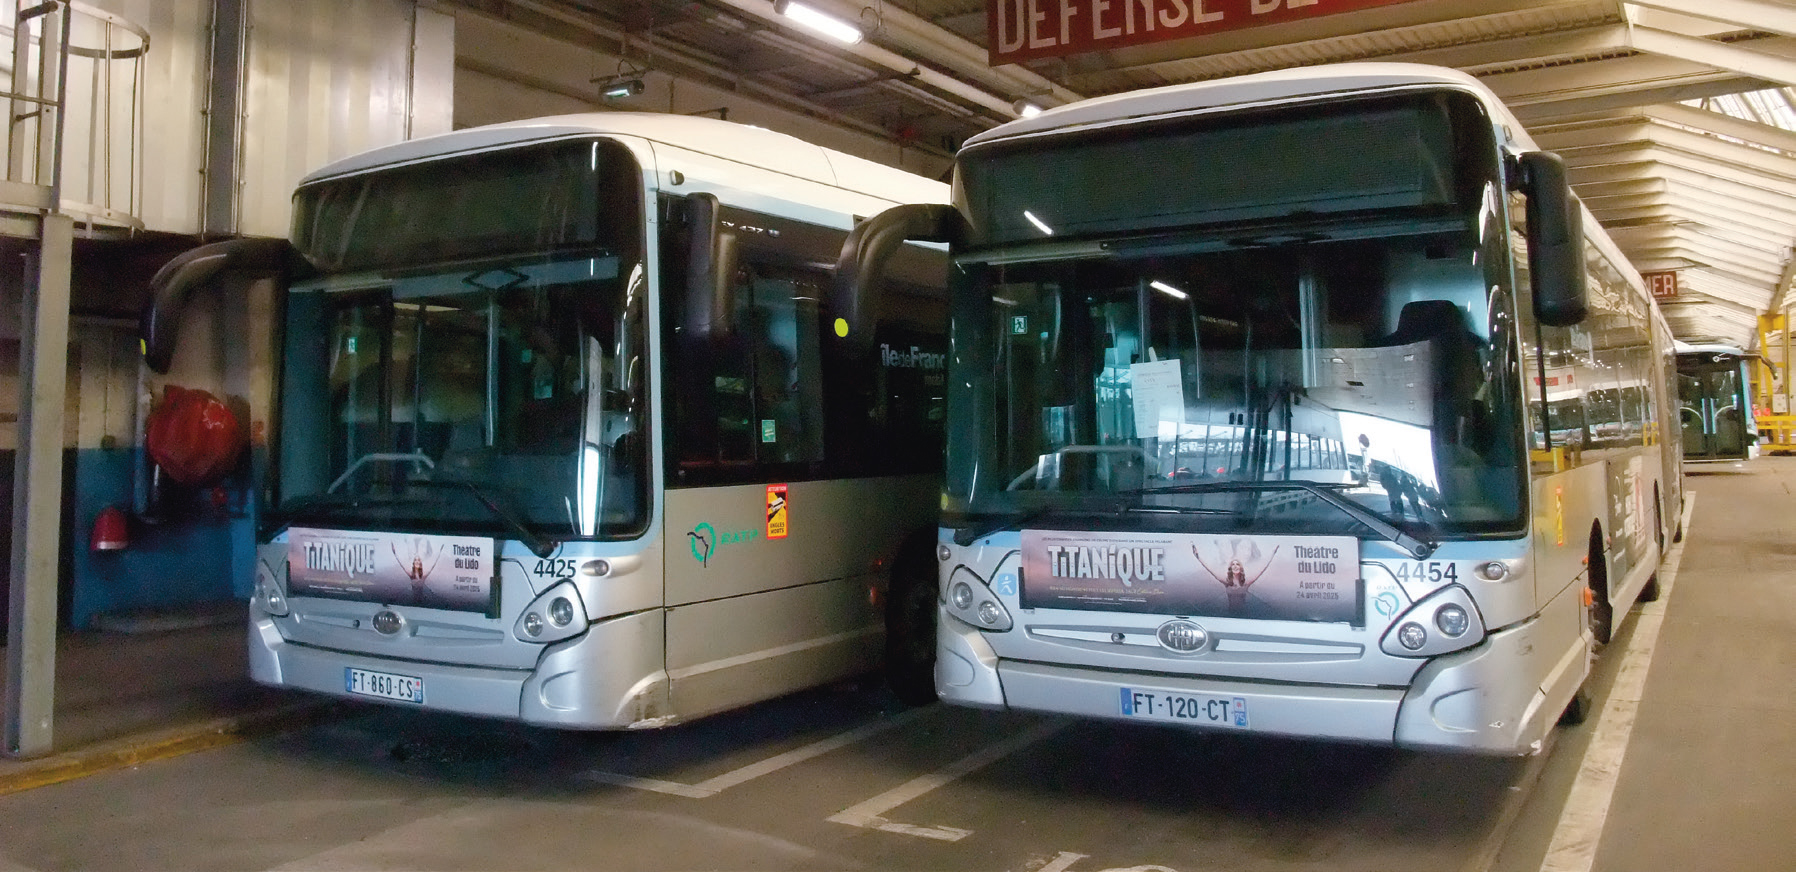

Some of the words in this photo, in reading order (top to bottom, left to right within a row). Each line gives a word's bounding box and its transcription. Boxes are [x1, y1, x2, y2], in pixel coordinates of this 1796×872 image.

[721, 529, 758, 544] RATP
[455, 558, 463, 568] du
[533, 560, 577, 578] 4425
[1298, 561, 1311, 573] du
[1313, 561, 1336, 574] Lido
[1397, 562, 1458, 583] 4454
[1296, 591, 1305, 599] 24
[1306, 591, 1321, 600] avril
[1322, 592, 1339, 600] 2025
[352, 672, 413, 698] FT-860-CS
[1133, 693, 1230, 721] FT-120-CT
[1235, 712, 1246, 723] 75
